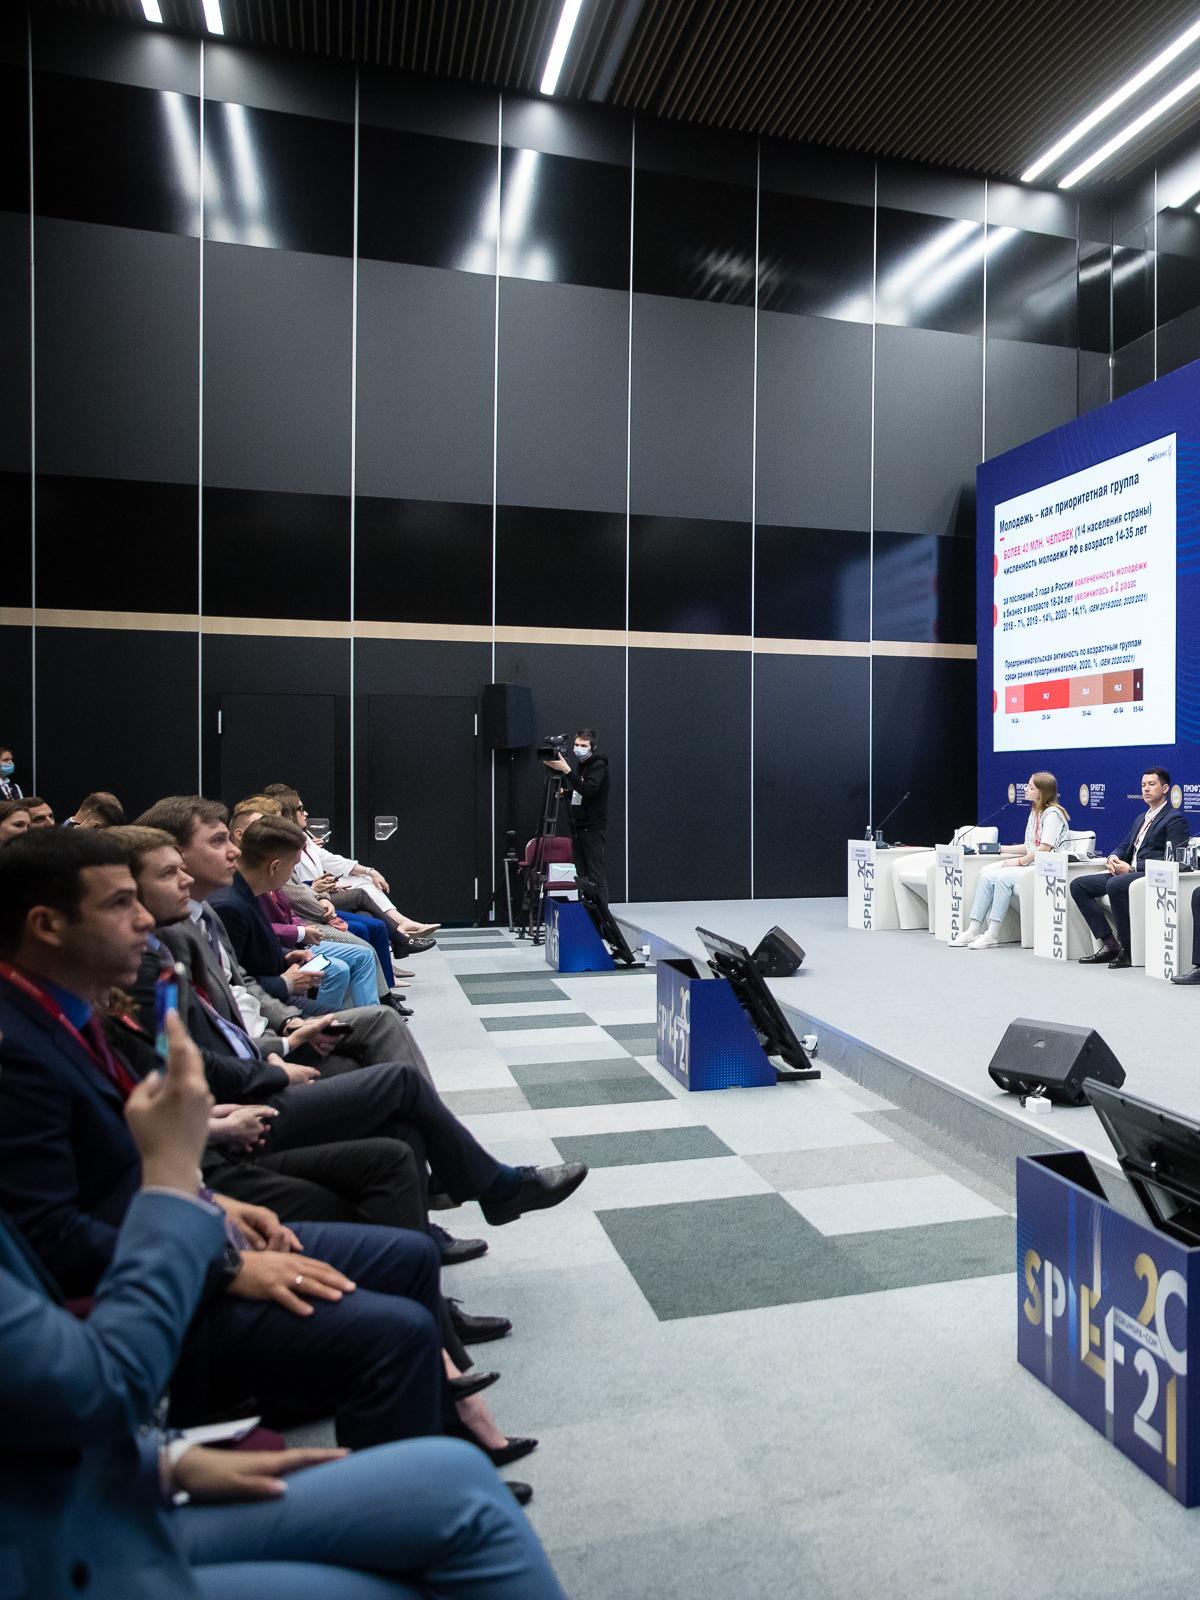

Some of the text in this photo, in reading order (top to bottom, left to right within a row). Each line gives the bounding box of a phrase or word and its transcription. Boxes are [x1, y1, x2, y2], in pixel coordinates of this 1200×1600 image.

[1000, 473, 1139, 534] Молодежь как приоритетная группа
[1004, 545, 1020, 560] БОЛЕЕ
[1046, 528, 1073, 547] ЧЕЛОВЕК
[1087, 513, 1122, 534] населения
[1124, 502, 1151, 525] страны)
[1004, 559, 1037, 575] численность
[1039, 549, 1068, 565] молодежи
[1070, 544, 1078, 556] РФ
[1085, 535, 1113, 553] возрасте
[1116, 526, 1133, 542] 14-35
[1135, 525, 1147, 536] лет
[1055, 580, 1073, 592] России
[1116, 561, 1147, 577] молодежи
[1167, 891, 1176, 913] 21
[1053, 903, 1066, 958] SPIEF
[1133, 1348, 1177, 1467] 21
